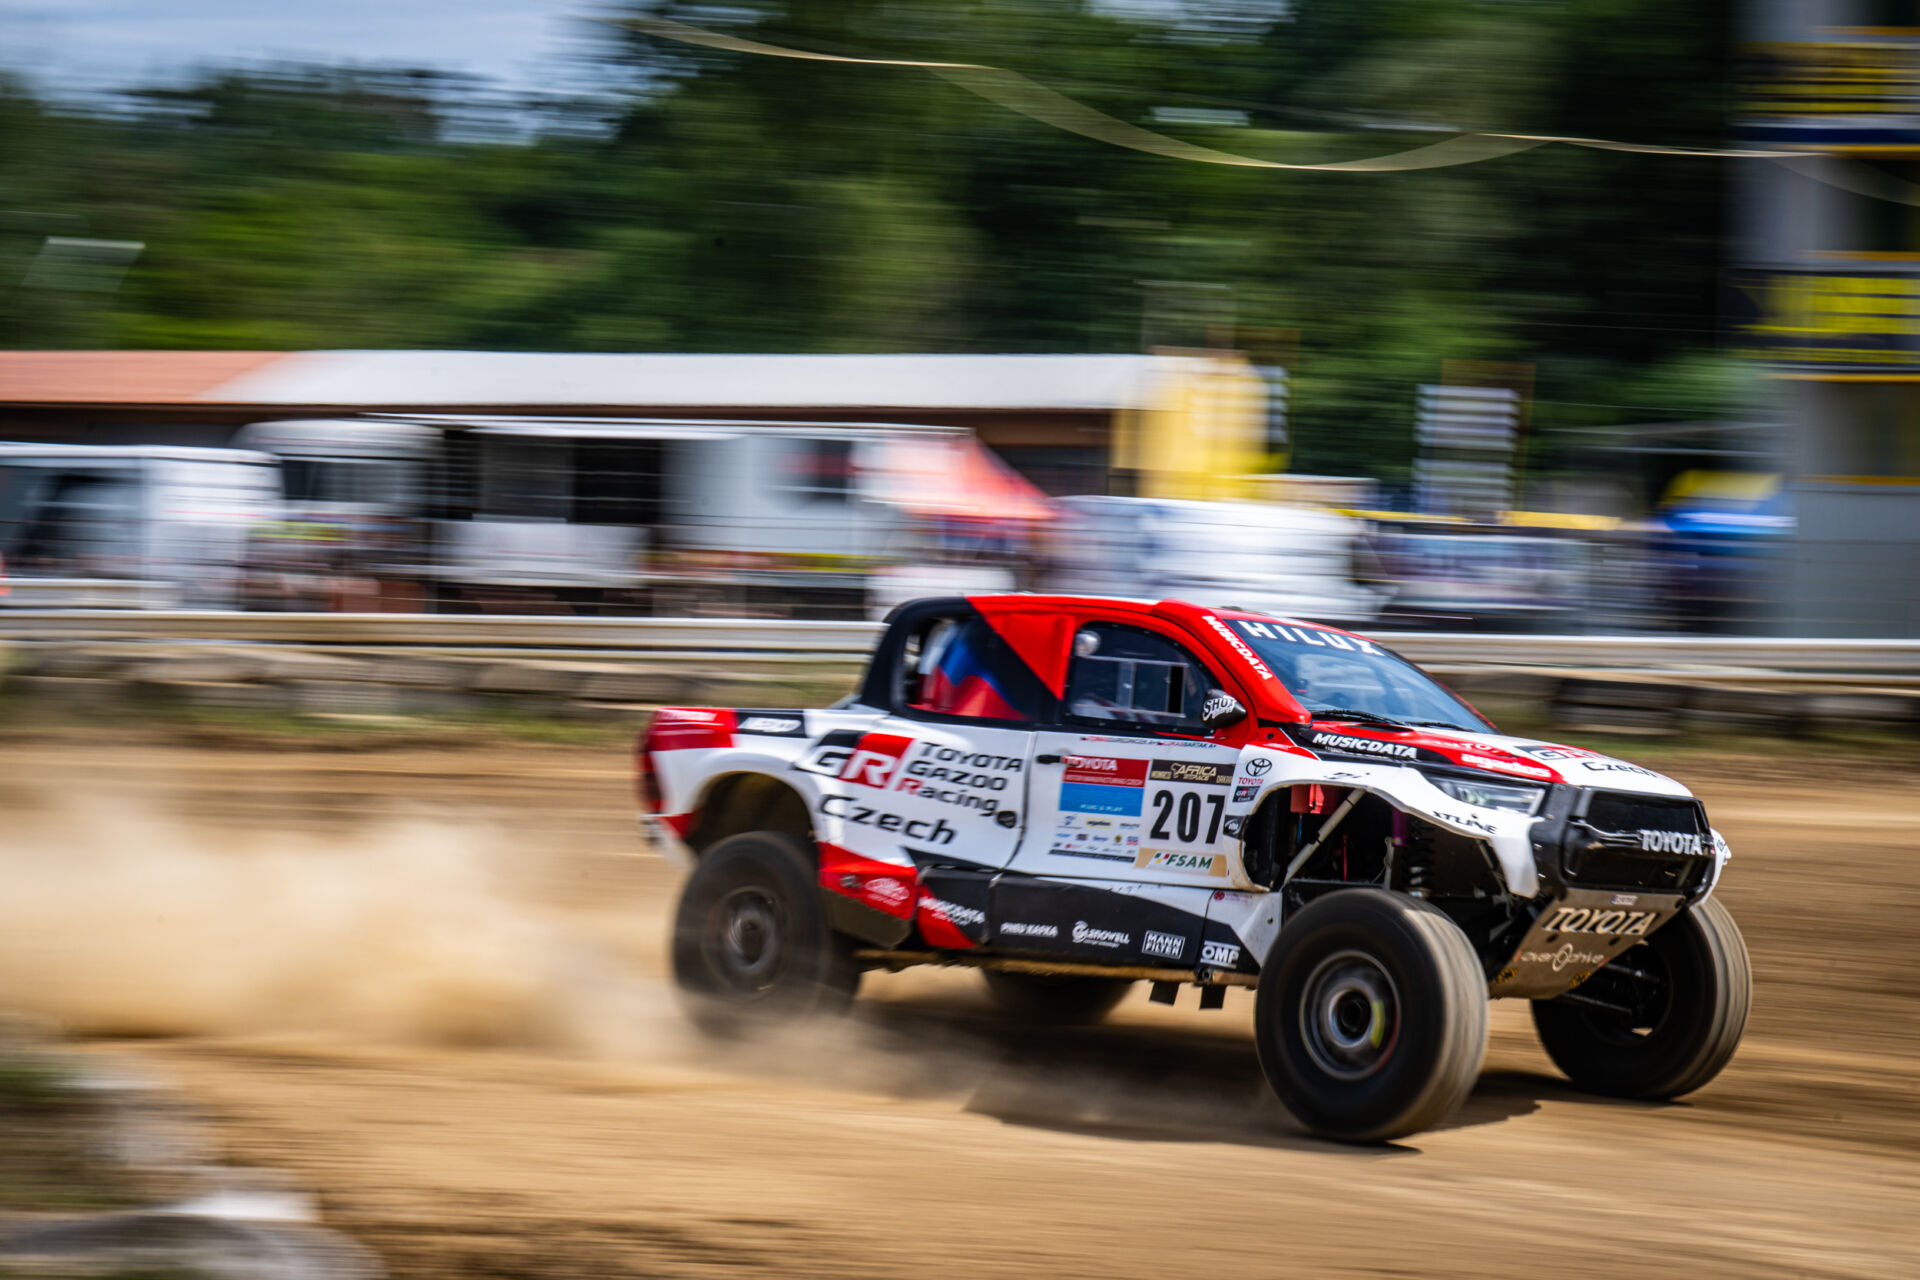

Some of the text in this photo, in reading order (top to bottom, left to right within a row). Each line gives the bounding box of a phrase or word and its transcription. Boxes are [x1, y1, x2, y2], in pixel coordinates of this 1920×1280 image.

[1201, 615, 1273, 680] MUSICDATA
[1237, 620, 1386, 657] HILUX
[920, 742, 1024, 773] TOYOTA
[1312, 733, 1418, 759] MUSICDATA
[905, 760, 1008, 791] GAZOO
[1175, 764, 1217, 777] AFRICA
[896, 777, 1000, 817] Racing
[819, 794, 958, 844] Czech
[1149, 790, 1226, 845] 207
[1639, 828, 1703, 855] TOYOTA
[1166, 854, 1214, 869] FSAM
[1542, 907, 1660, 935] TOYOTA
[1147, 934, 1182, 948] MANN
[1202, 945, 1240, 965] OMP
